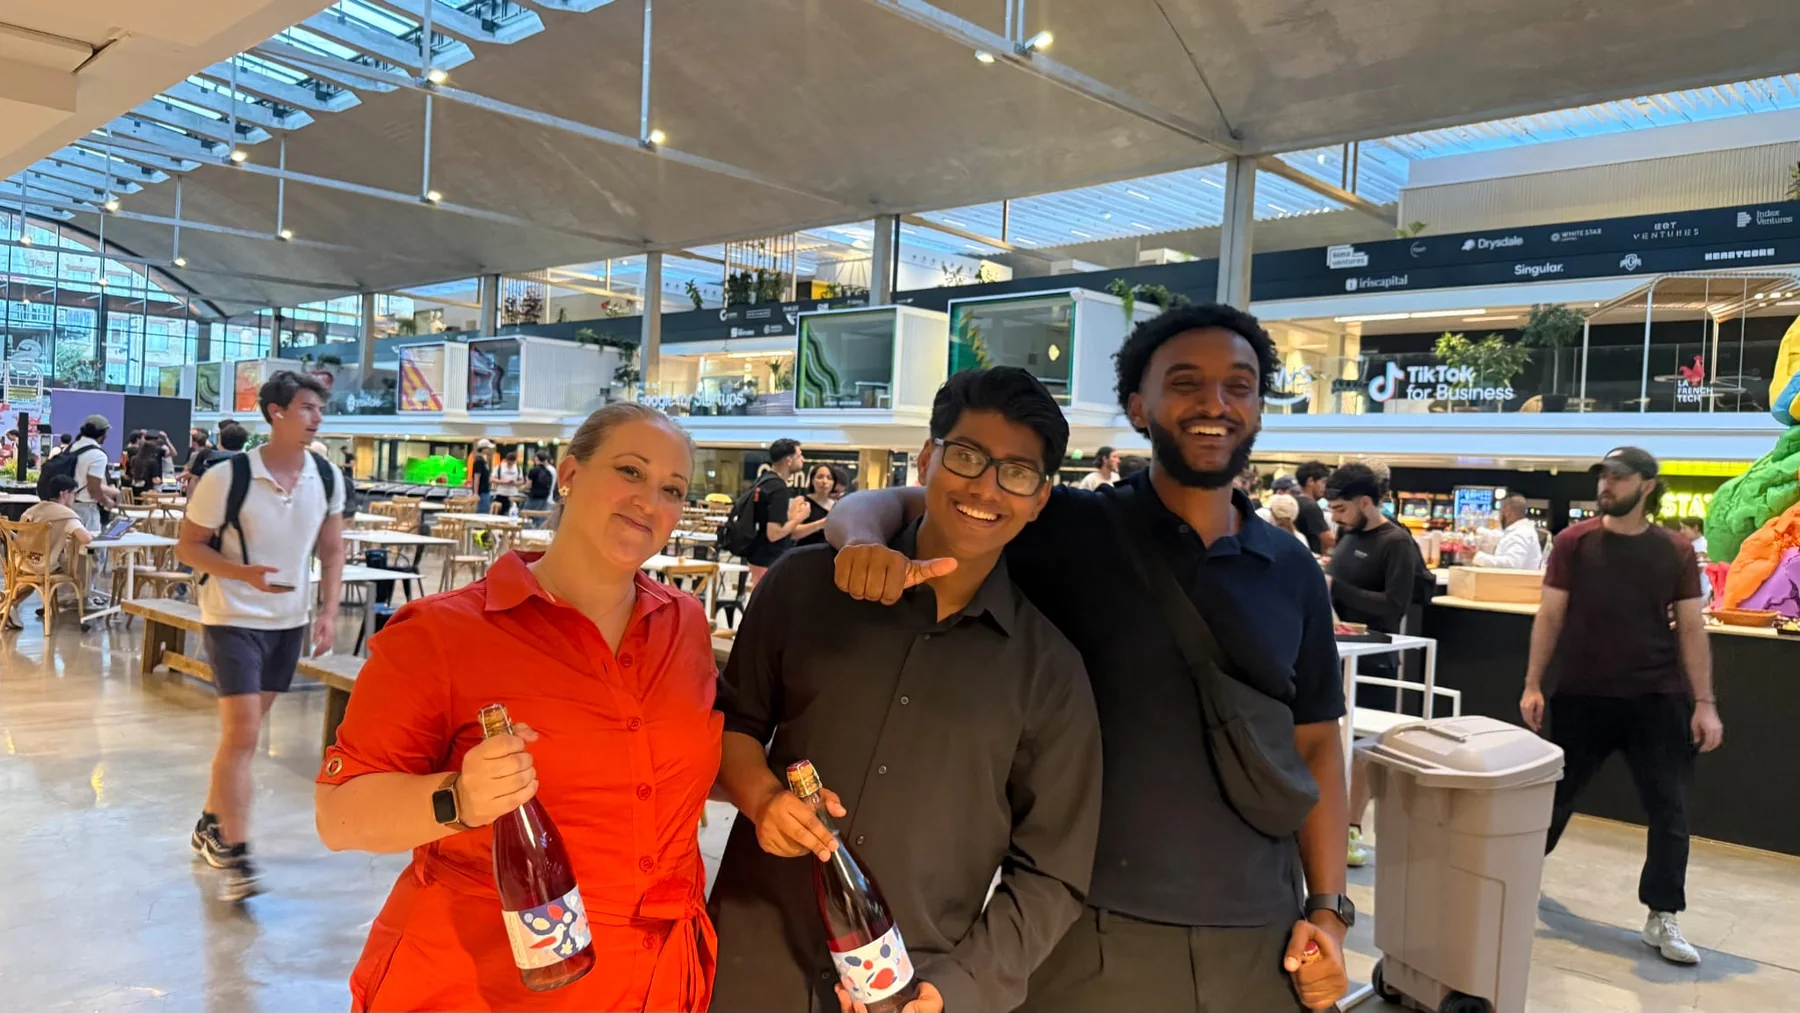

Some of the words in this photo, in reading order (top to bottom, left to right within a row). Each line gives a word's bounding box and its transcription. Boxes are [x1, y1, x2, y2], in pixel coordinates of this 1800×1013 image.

[1757, 210, 1780, 218] Index
[1756, 216, 1793, 226] Ventures
[1585, 228, 1602, 236] STAR
[1633, 228, 1699, 240] VENTURES
[1477, 235, 1524, 250] Drysdale
[1514, 262, 1564, 277] Singular.
[1359, 274, 1408, 289] iriscapital
[1406, 364, 1475, 383] TikTok
[1677, 379, 1689, 387] LA
[1406, 384, 1434, 401] for
[1436, 384, 1515, 401] Business
[1677, 387, 1714, 395] FRENCH
[634, 389, 673, 411] Google
[677, 392, 691, 406] for
[694, 390, 744, 409] Startups
[1677, 395, 1701, 403] TECH
